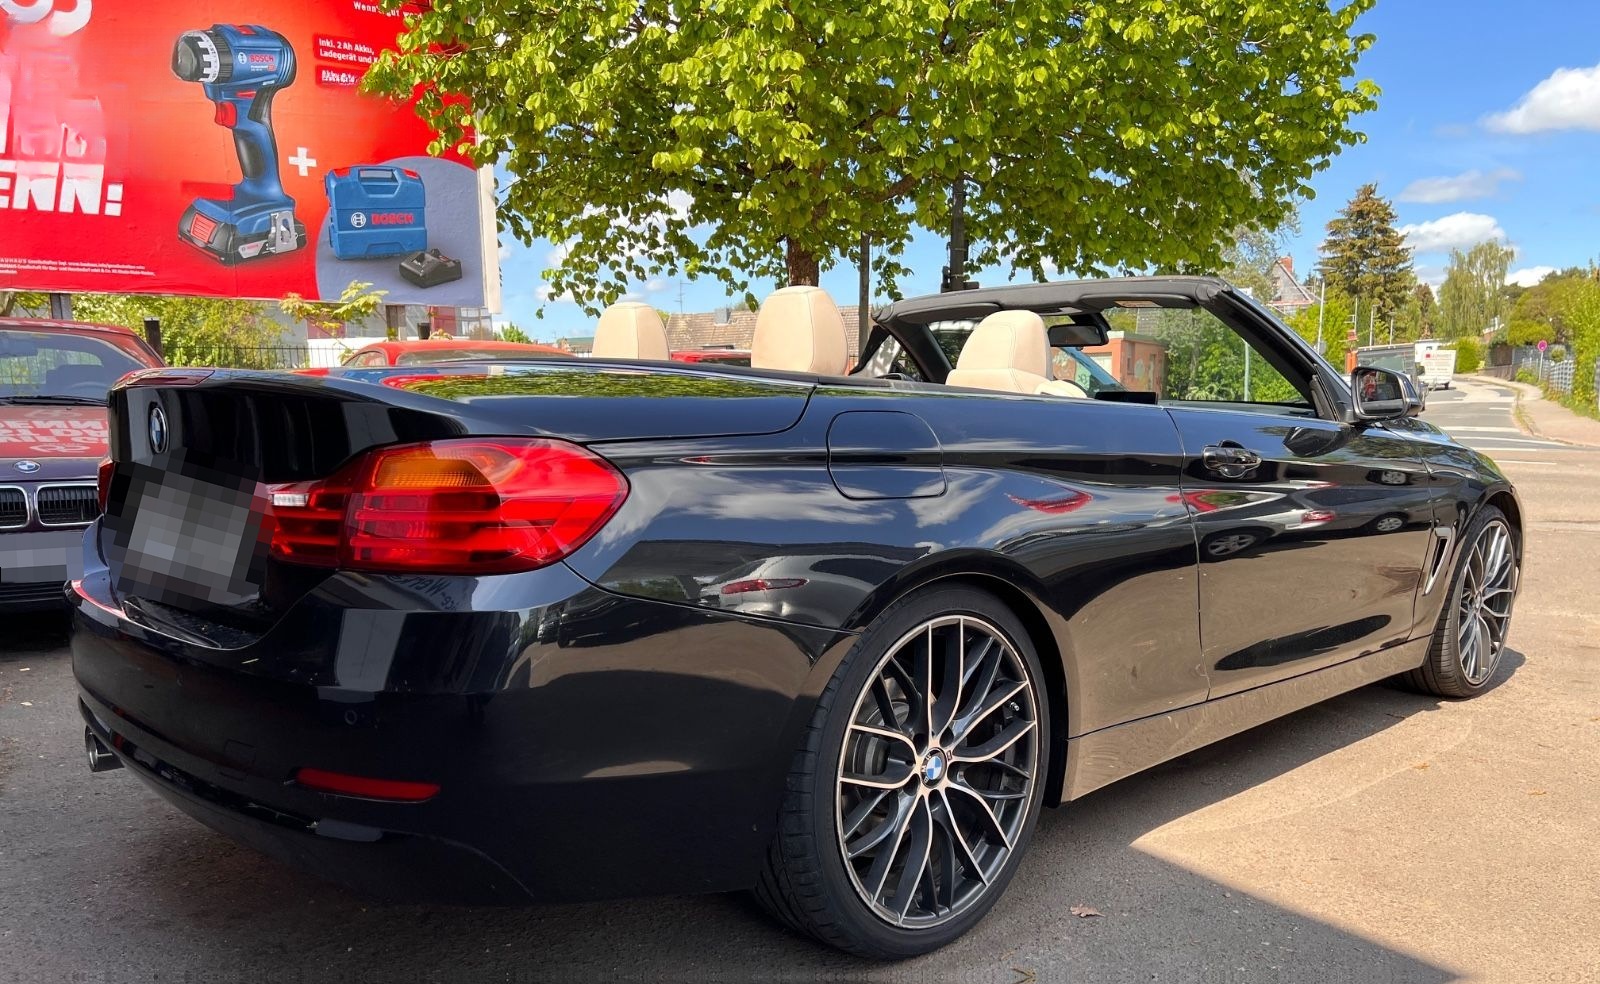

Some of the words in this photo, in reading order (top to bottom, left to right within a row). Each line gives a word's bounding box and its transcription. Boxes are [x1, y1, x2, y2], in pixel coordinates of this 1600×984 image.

[318, 38, 335, 48] Inkl.
[343, 42, 353, 50] Ah
[354, 43, 374, 55] Akku,
[249, 54, 274, 63] BOSCH
[320, 48, 357, 61] Ladegerät
[358, 55, 372, 63] und
[371, 213, 414, 225] BOSCH
